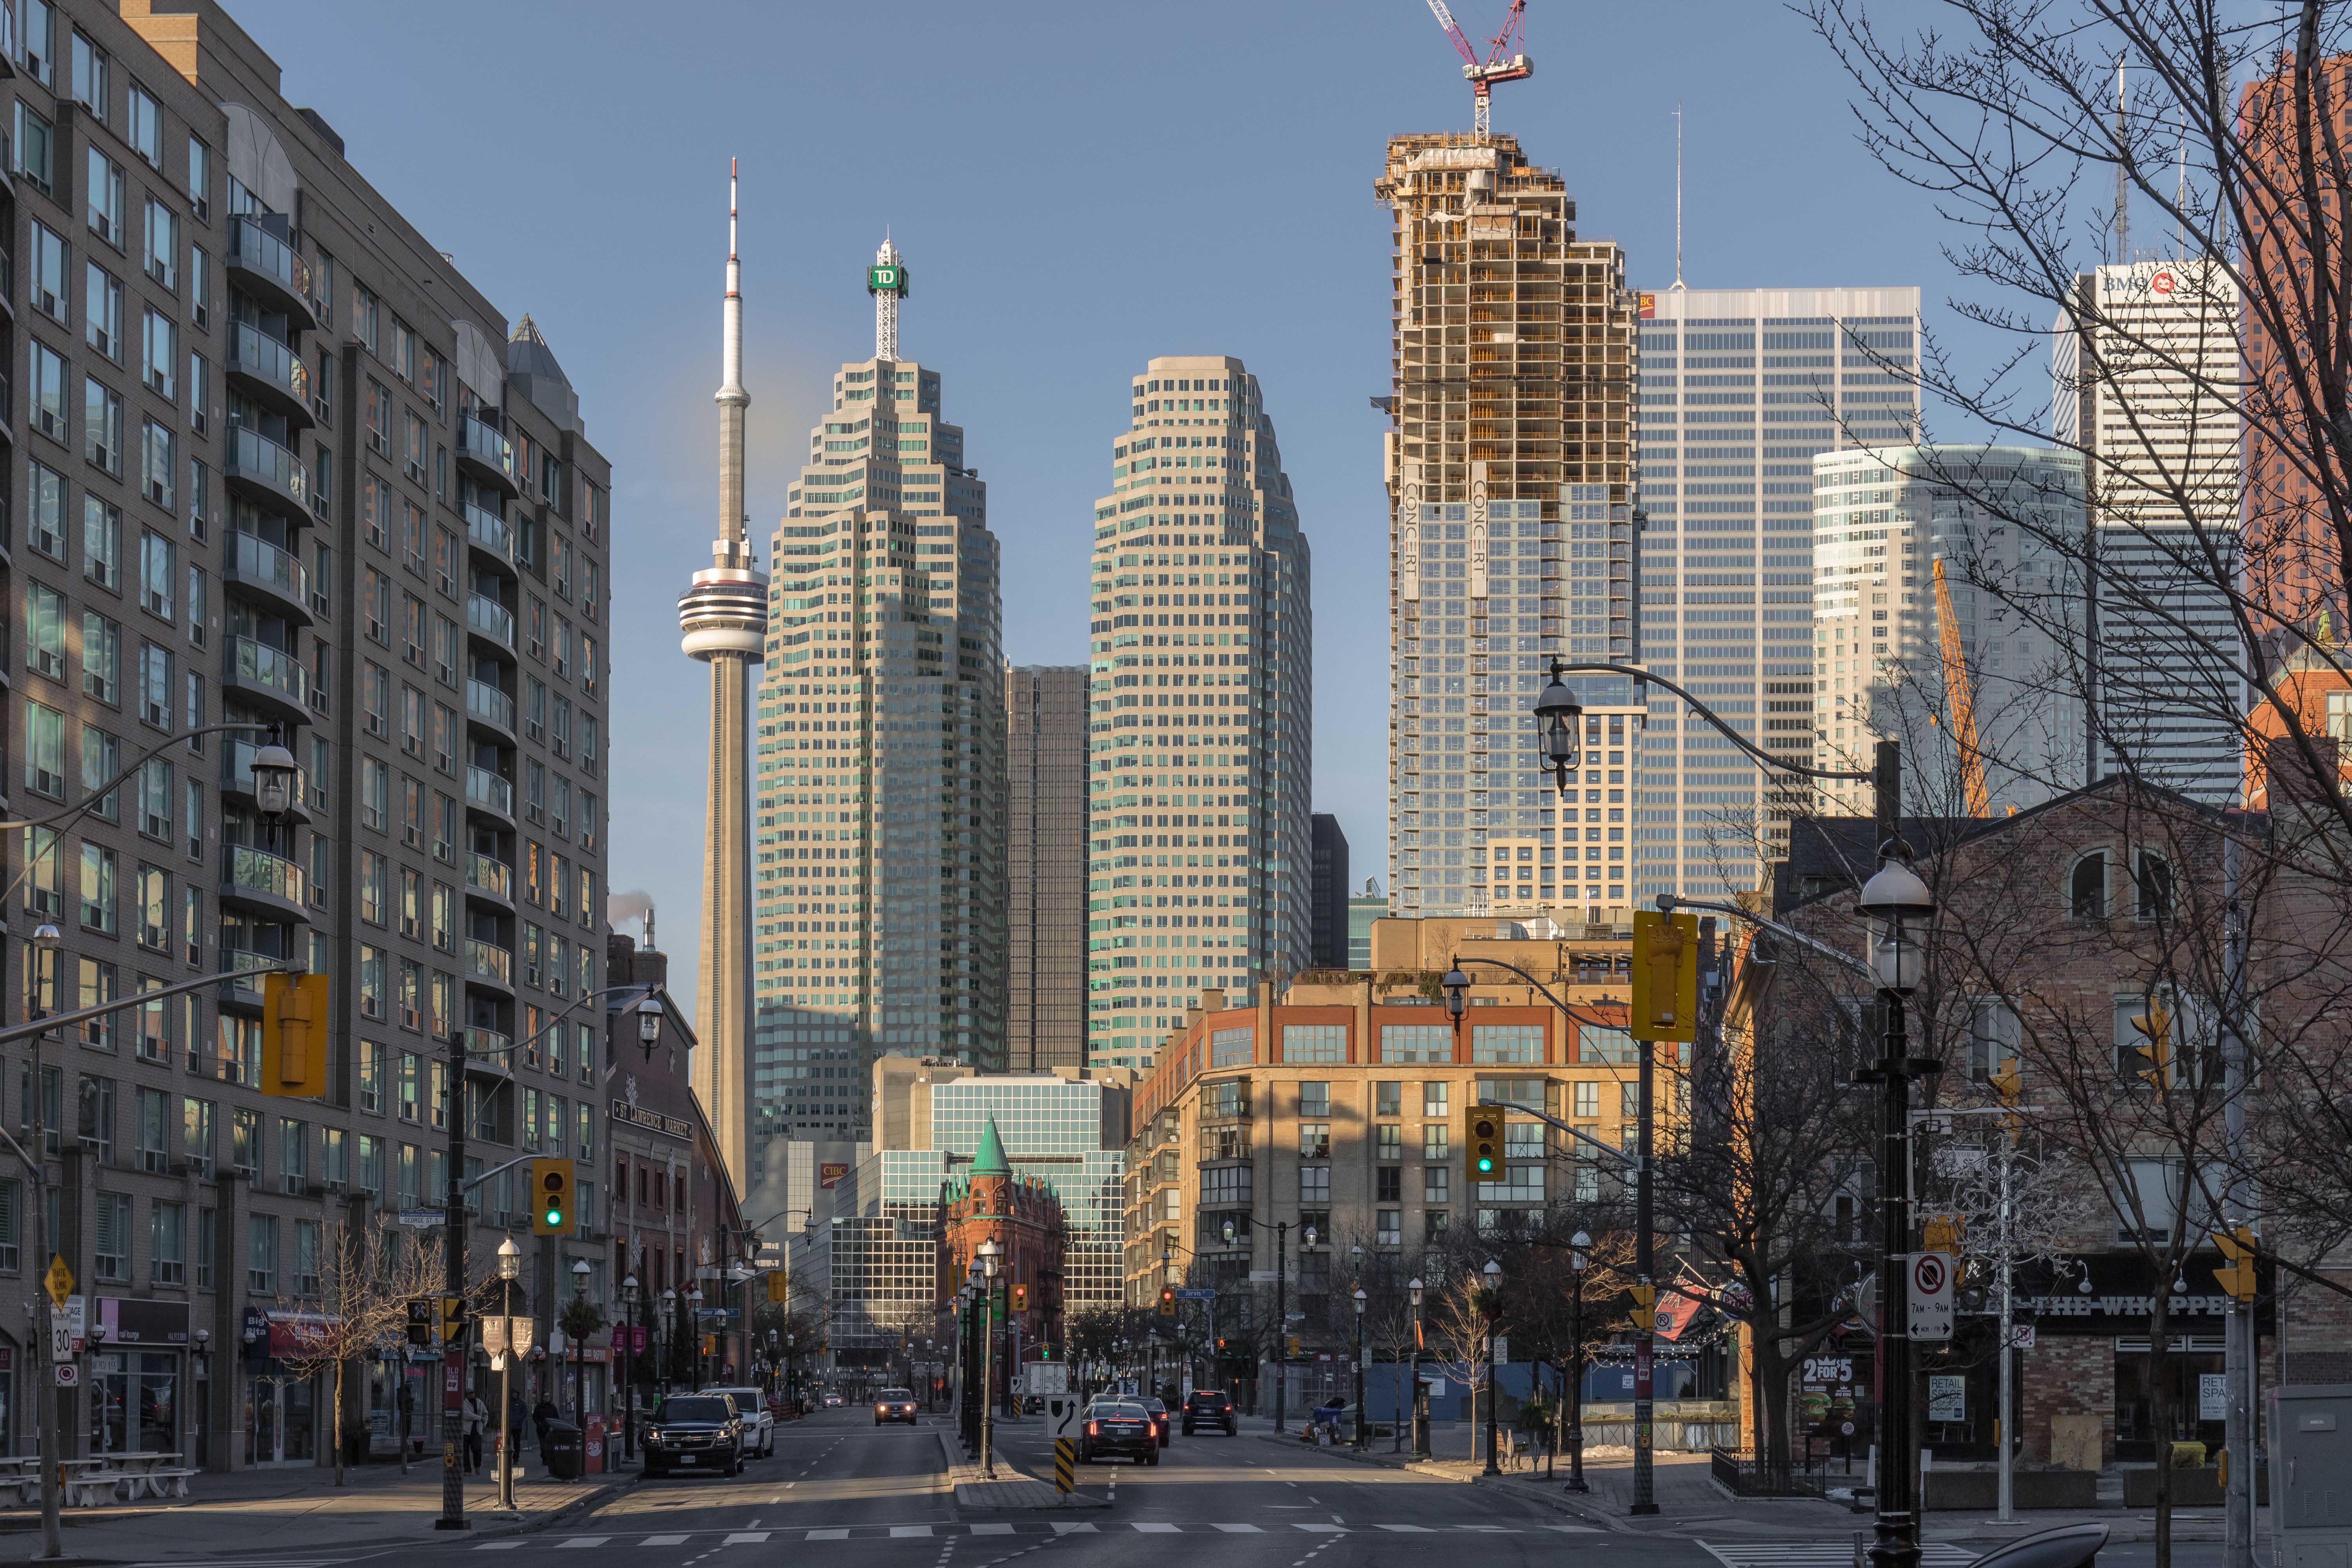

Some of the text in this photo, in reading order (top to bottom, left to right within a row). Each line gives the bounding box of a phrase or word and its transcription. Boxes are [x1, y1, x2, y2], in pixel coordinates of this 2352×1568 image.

[875, 270, 894, 283] TD
[2103, 277, 2147, 291] BMO
[1640, 297, 1653, 306] BC
[1406, 483, 1418, 577] CONCERT
[1474, 480, 1486, 575] CONCERT
[620, 1103, 688, 1137] ST LAWRENCE MARKET
[823, 1166, 846, 1175] CIBC
[53, 1268, 66, 1277] TRAFFIC
[52, 1280, 67, 1290] CALMING
[56, 1293, 65, 1303] ZONE
[1911, 1303, 1924, 1314] 7AM
[1935, 1303, 1949, 1313] 9AM
[2031, 1296, 2226, 1316] THE WHPPE
[248, 1317, 265, 1327] Big
[56, 1329, 70, 1352] 30
[127, 1330, 139, 1341] lounge
[1804, 1359, 1817, 1382] 2
[1817, 1366, 1838, 1378] FOR
[1932, 1379, 1962, 1388] RETAIL
[2203, 1377, 2226, 1387] RET
[2203, 1388, 2226, 1398] SPA
